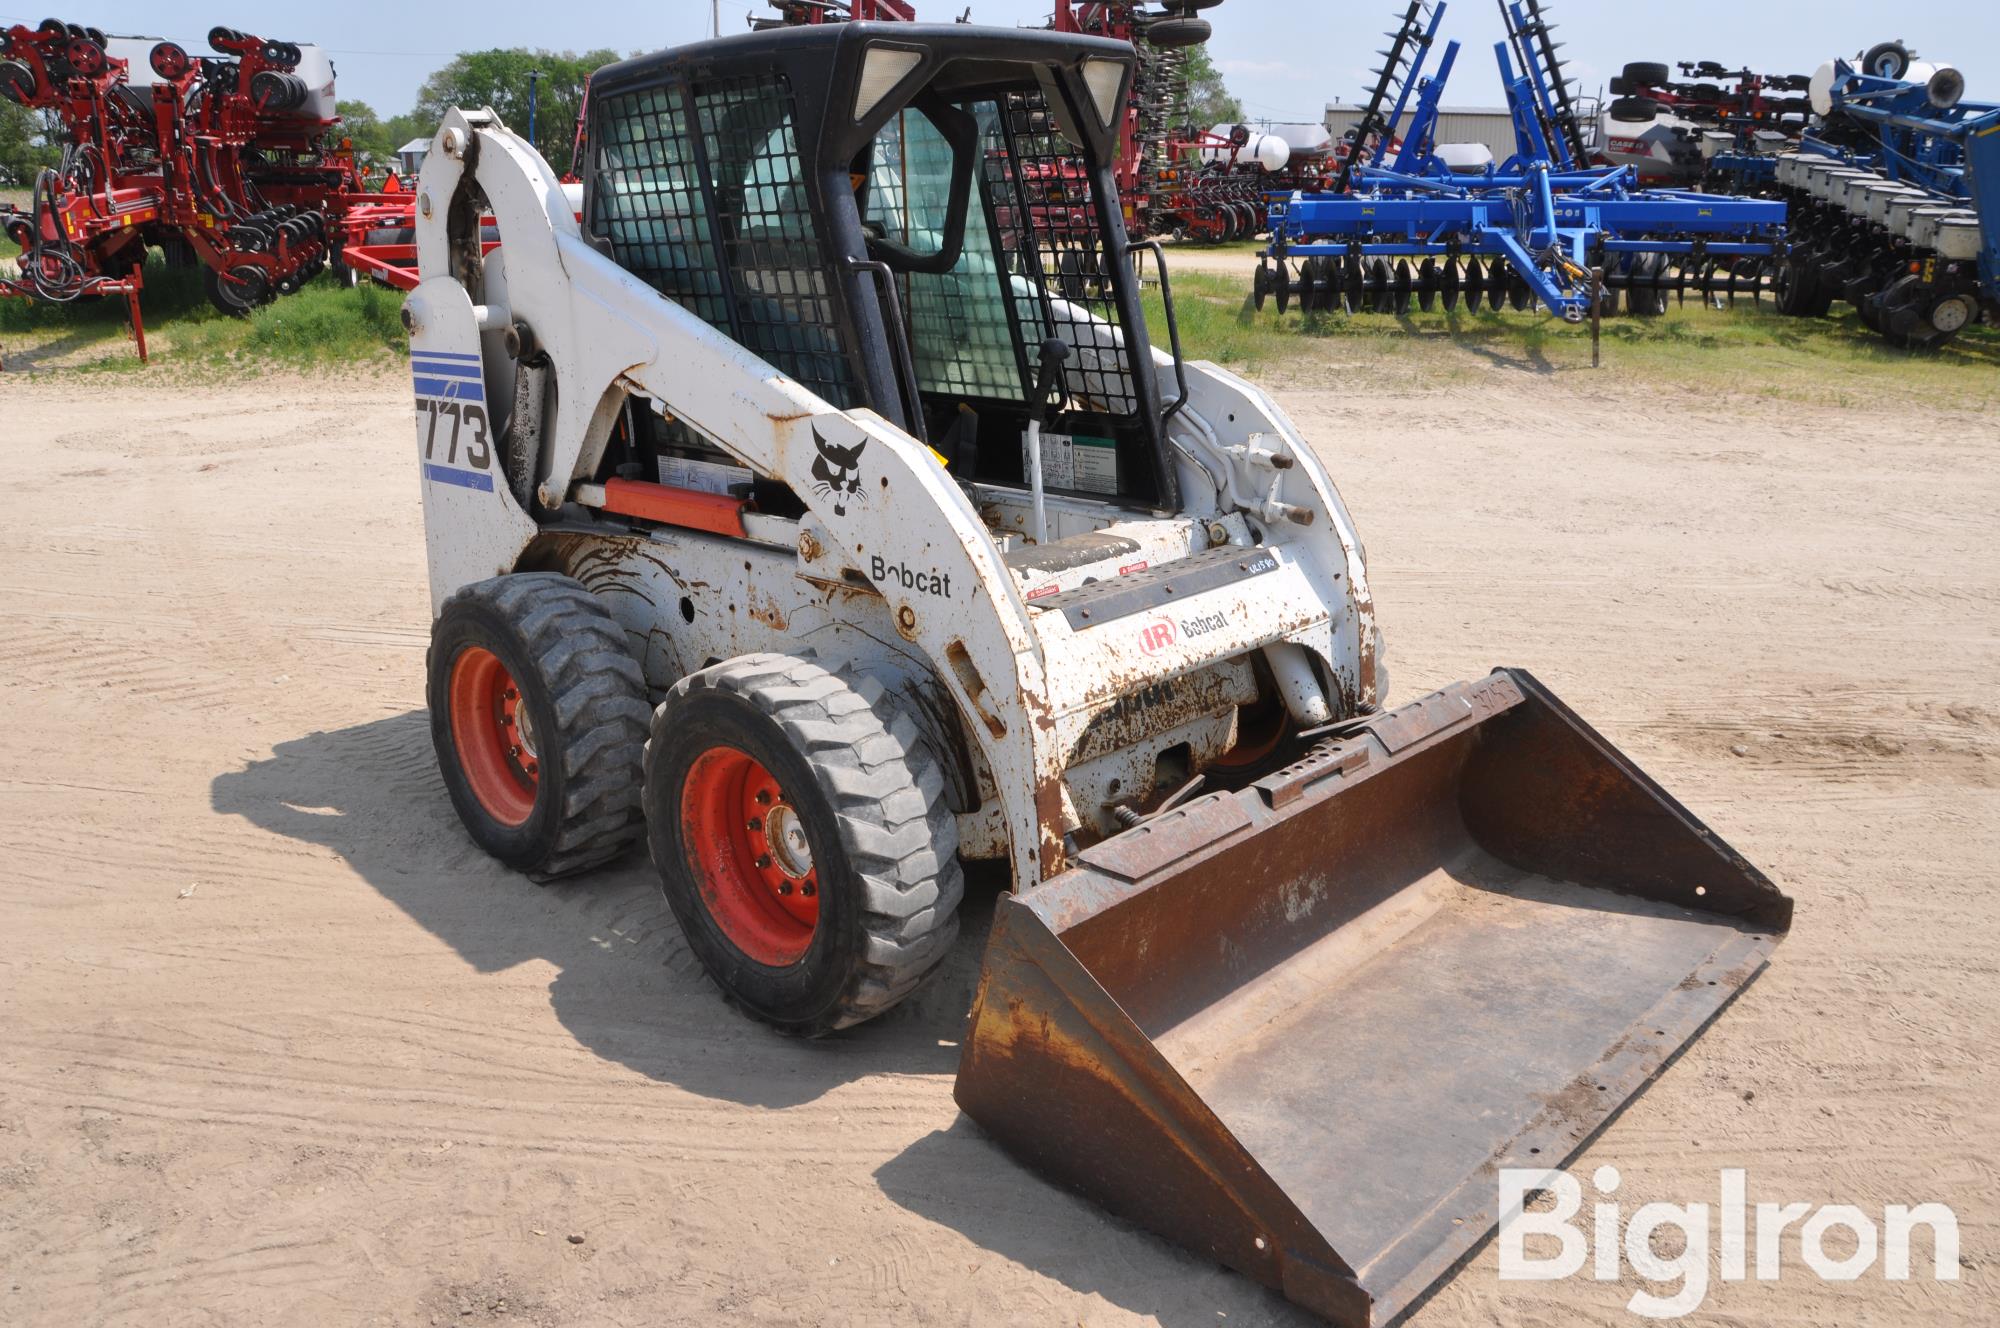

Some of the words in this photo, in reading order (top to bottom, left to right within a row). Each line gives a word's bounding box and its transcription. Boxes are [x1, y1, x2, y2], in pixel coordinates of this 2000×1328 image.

[416, 398, 491, 470] 773
[1141, 622, 1174, 652] IR
[1181, 611, 1229, 639] Bobcat
